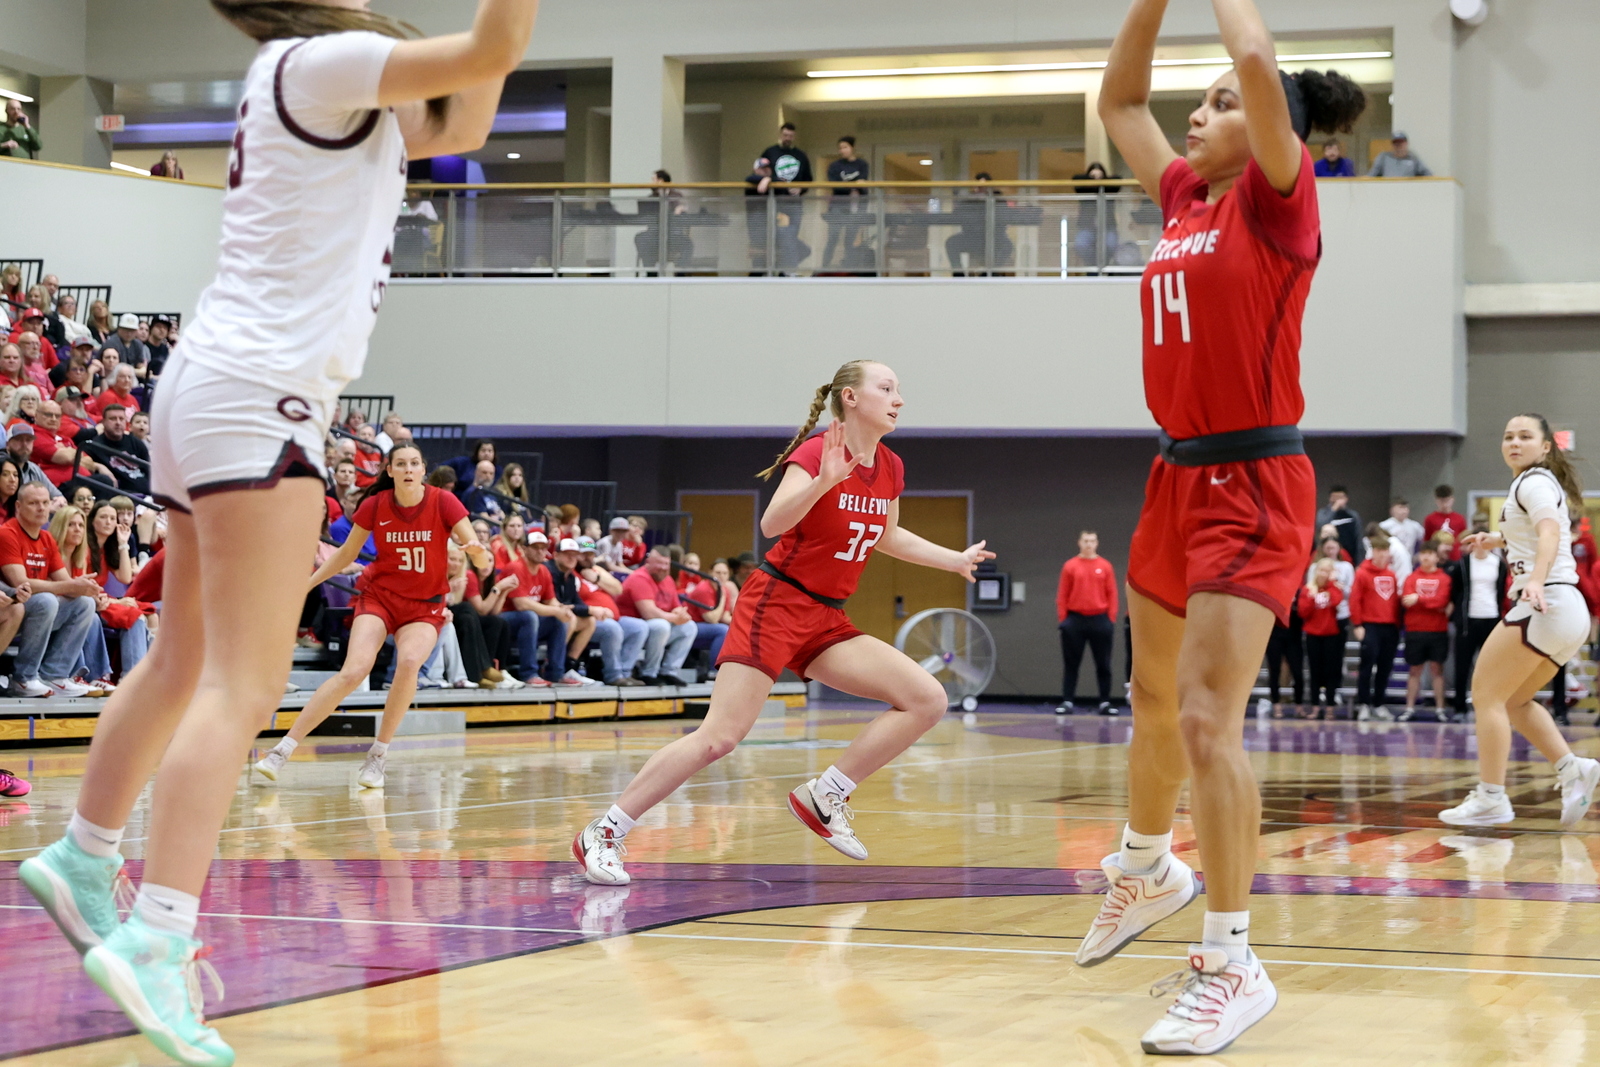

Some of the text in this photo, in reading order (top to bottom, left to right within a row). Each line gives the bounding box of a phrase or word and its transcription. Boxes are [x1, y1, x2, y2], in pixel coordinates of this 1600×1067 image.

[1150, 270, 1191, 346] 14
[386, 530, 432, 543] BELLEVUE
[833, 521, 884, 562] 32
[396, 546, 425, 574] 30
